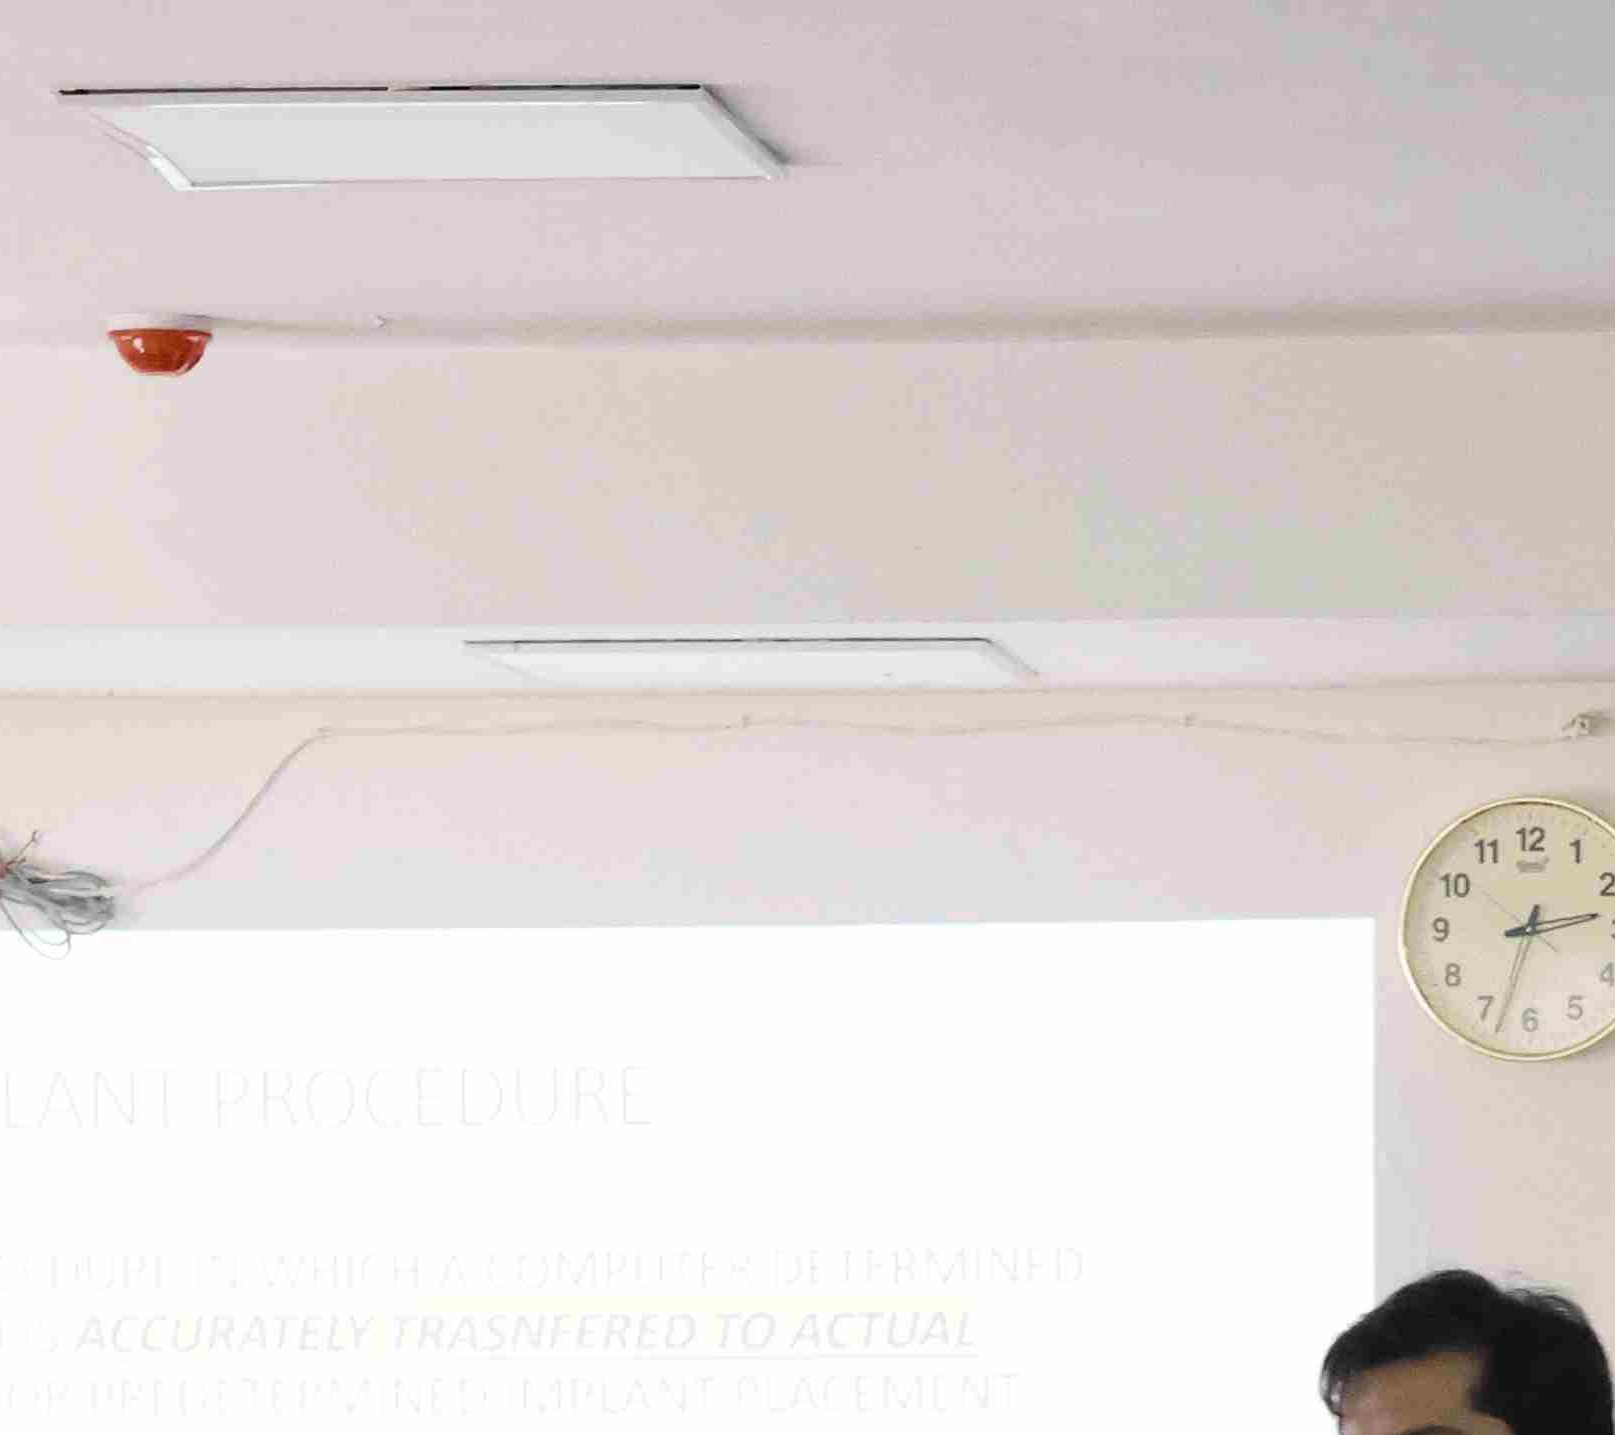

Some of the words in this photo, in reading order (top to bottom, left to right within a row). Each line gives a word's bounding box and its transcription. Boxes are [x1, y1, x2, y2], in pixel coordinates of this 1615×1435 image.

[1474, 840, 1499, 864] 11
[1515, 827, 1546, 853] 12
[1569, 840, 1582, 864] 1
[1440, 873, 1470, 898] 10
[1432, 917, 1450, 942] 9
[1445, 963, 1461, 987] 8
[1600, 962, 1615, 986] 4
[1477, 995, 1495, 1020] 7
[1522, 1008, 1539, 1032] 6
[1567, 995, 1584, 1021] 5
[215, 1064, 652, 1129] PROCEDURE
[75, 1313, 375, 1353] ACCURATELY
[393, 1311, 697, 1352] TRASNFERED
[714, 1310, 778, 1351] TO
[789, 1310, 978, 1350] ACTUAL
